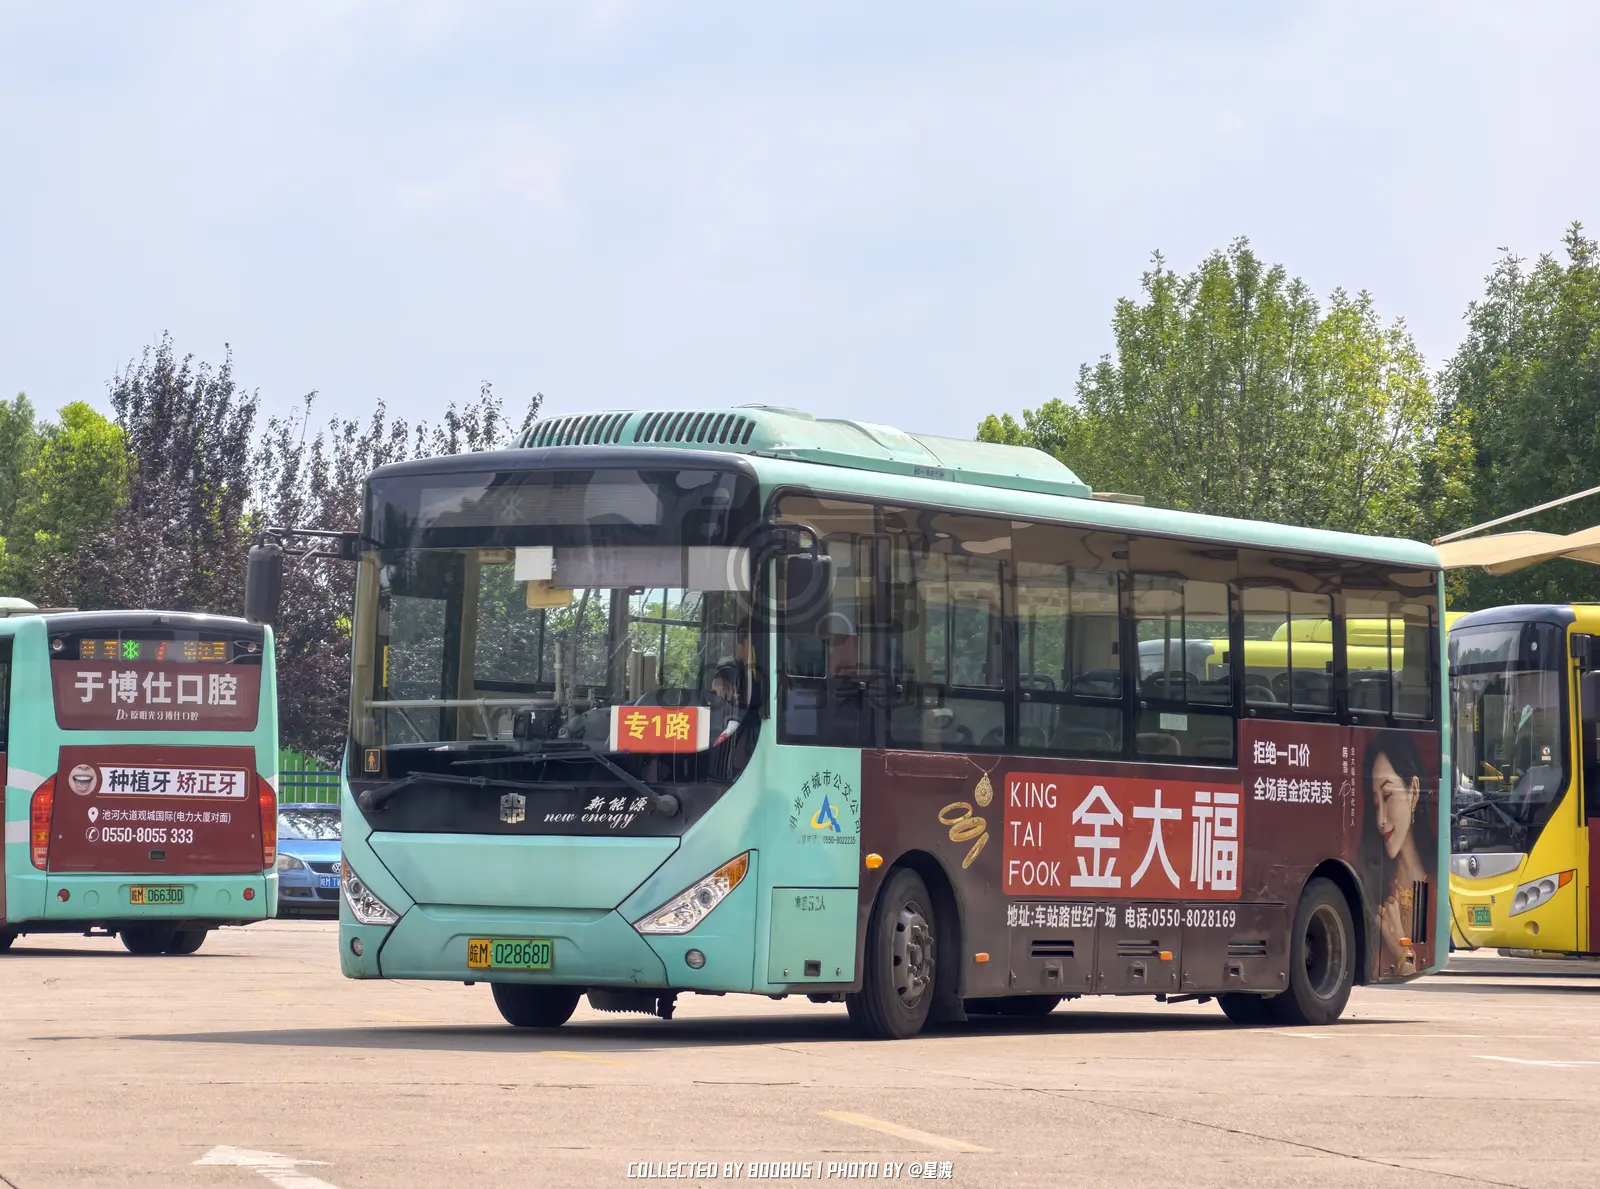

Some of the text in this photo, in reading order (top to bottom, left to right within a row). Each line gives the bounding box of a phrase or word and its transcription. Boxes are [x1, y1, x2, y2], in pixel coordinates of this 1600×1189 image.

[74, 670, 237, 705] 于博仕口腔
[624, 711, 691, 740] 专1路
[1253, 740, 1310, 767] 拒绝一口价
[108, 769, 237, 795] 种植牙 矫正牙
[1010, 782, 1057, 809] KING
[1253, 776, 1333, 804] 全场黄金按克卖
[584, 796, 648, 812] 新能源
[101, 827, 194, 843] 0550-8055 333
[543, 813, 637, 830] new energy
[1010, 821, 1042, 847] TAI
[1070, 785, 1240, 891] 金大福
[1008, 860, 1061, 887] FOOK
